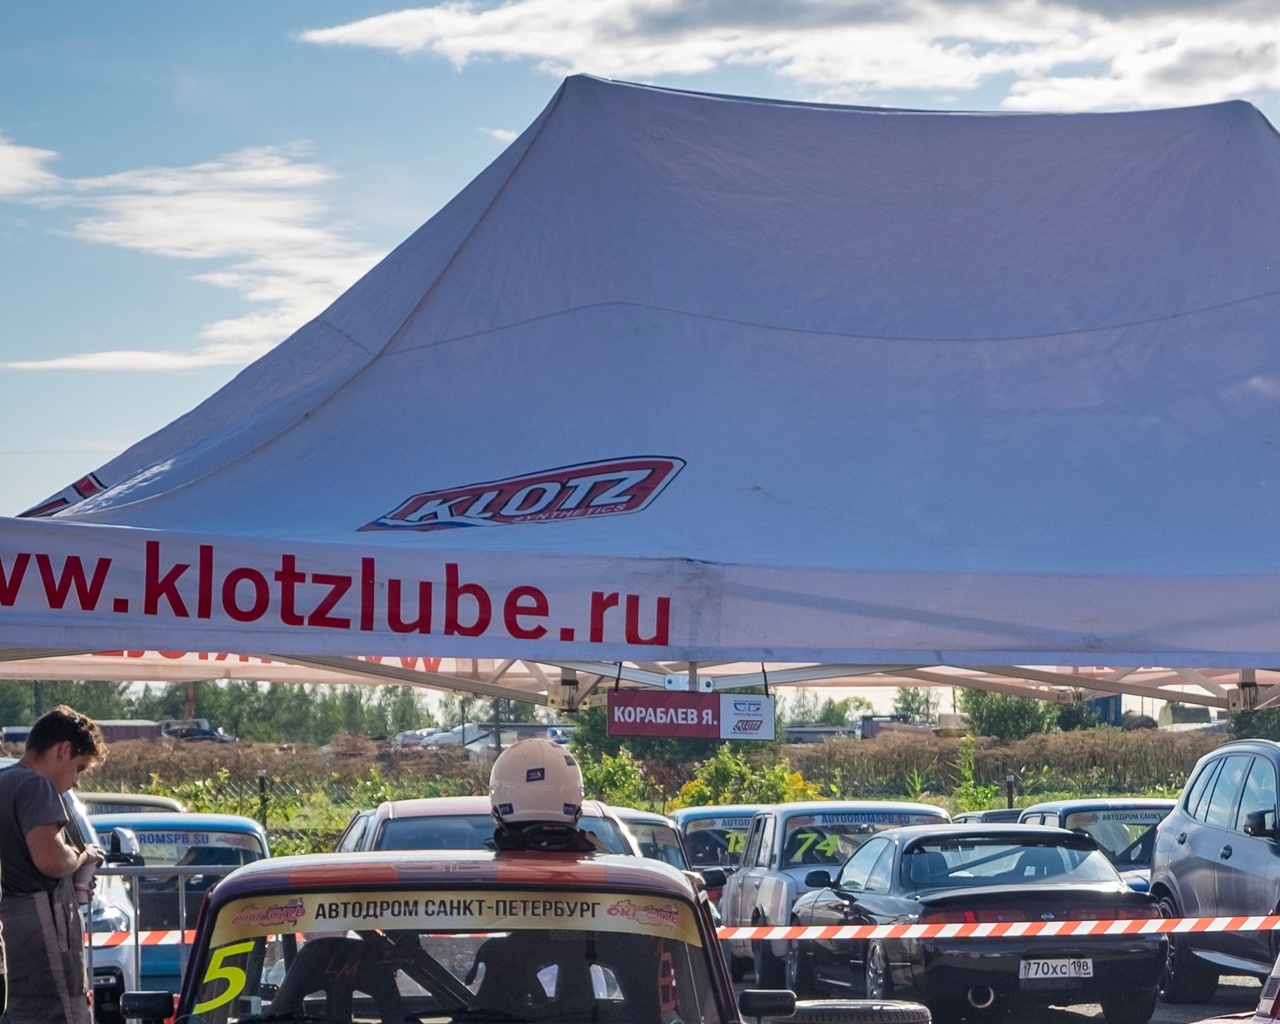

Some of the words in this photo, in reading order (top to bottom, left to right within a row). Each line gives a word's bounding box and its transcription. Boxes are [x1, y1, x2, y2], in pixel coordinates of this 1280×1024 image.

[404, 467, 653, 521] KLOTZ
[512, 502, 628, 524] SYNTHETICS
[613, 706, 698, 725] КОРАБЛЕВ
[701, 709, 718, 726] Я.
[797, 832, 841, 857] 74
[315, 900, 419, 920] АВТОДРОМ
[424, 899, 601, 919] САНКТ-ПЕТЕРБУРГ
[1070, 960, 1089, 971] 198
[192, 941, 256, 1015] 5
